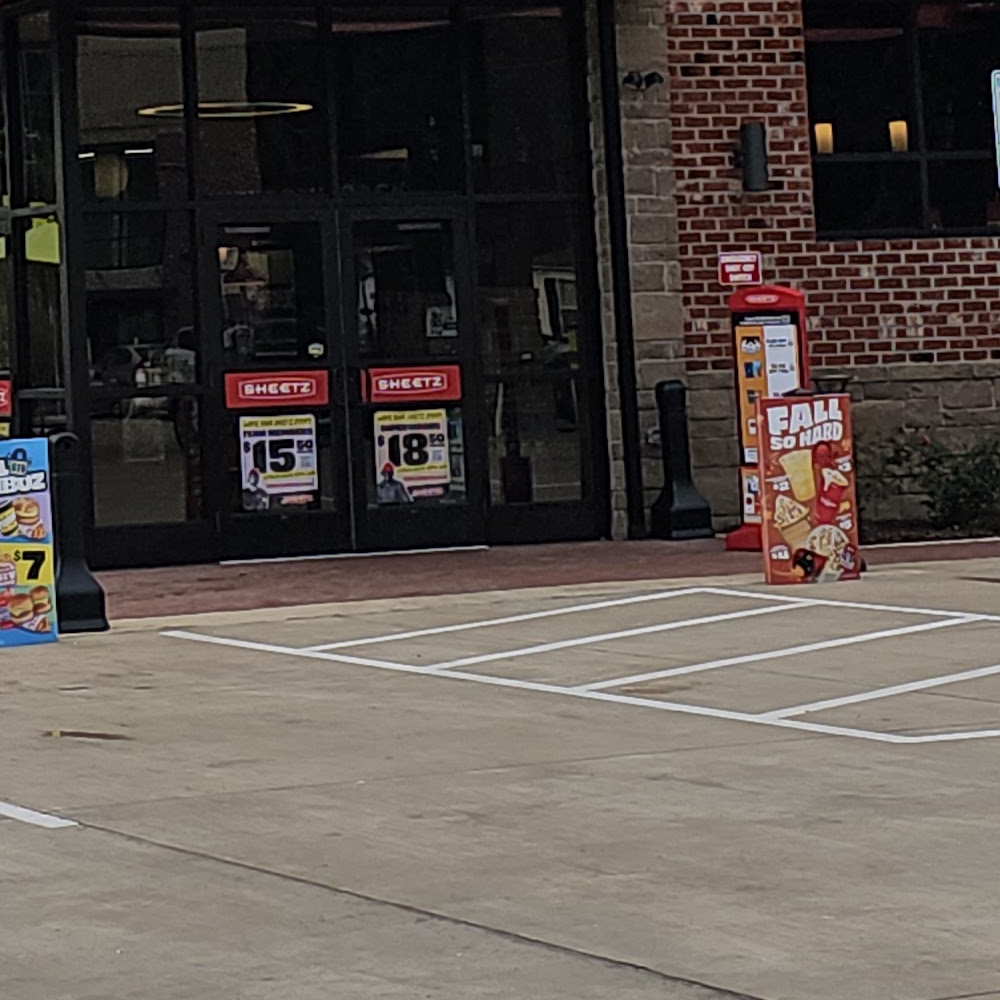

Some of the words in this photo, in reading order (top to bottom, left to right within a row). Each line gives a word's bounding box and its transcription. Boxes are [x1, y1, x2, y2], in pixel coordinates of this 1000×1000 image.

[243, 382, 312, 396] SHEETZ
[378, 376, 443, 390] SHEETZ
[766, 398, 843, 436] FALL
[770, 435, 797, 451] SO
[799, 421, 843, 448] HARD
[13, 550, 47, 580] $7
